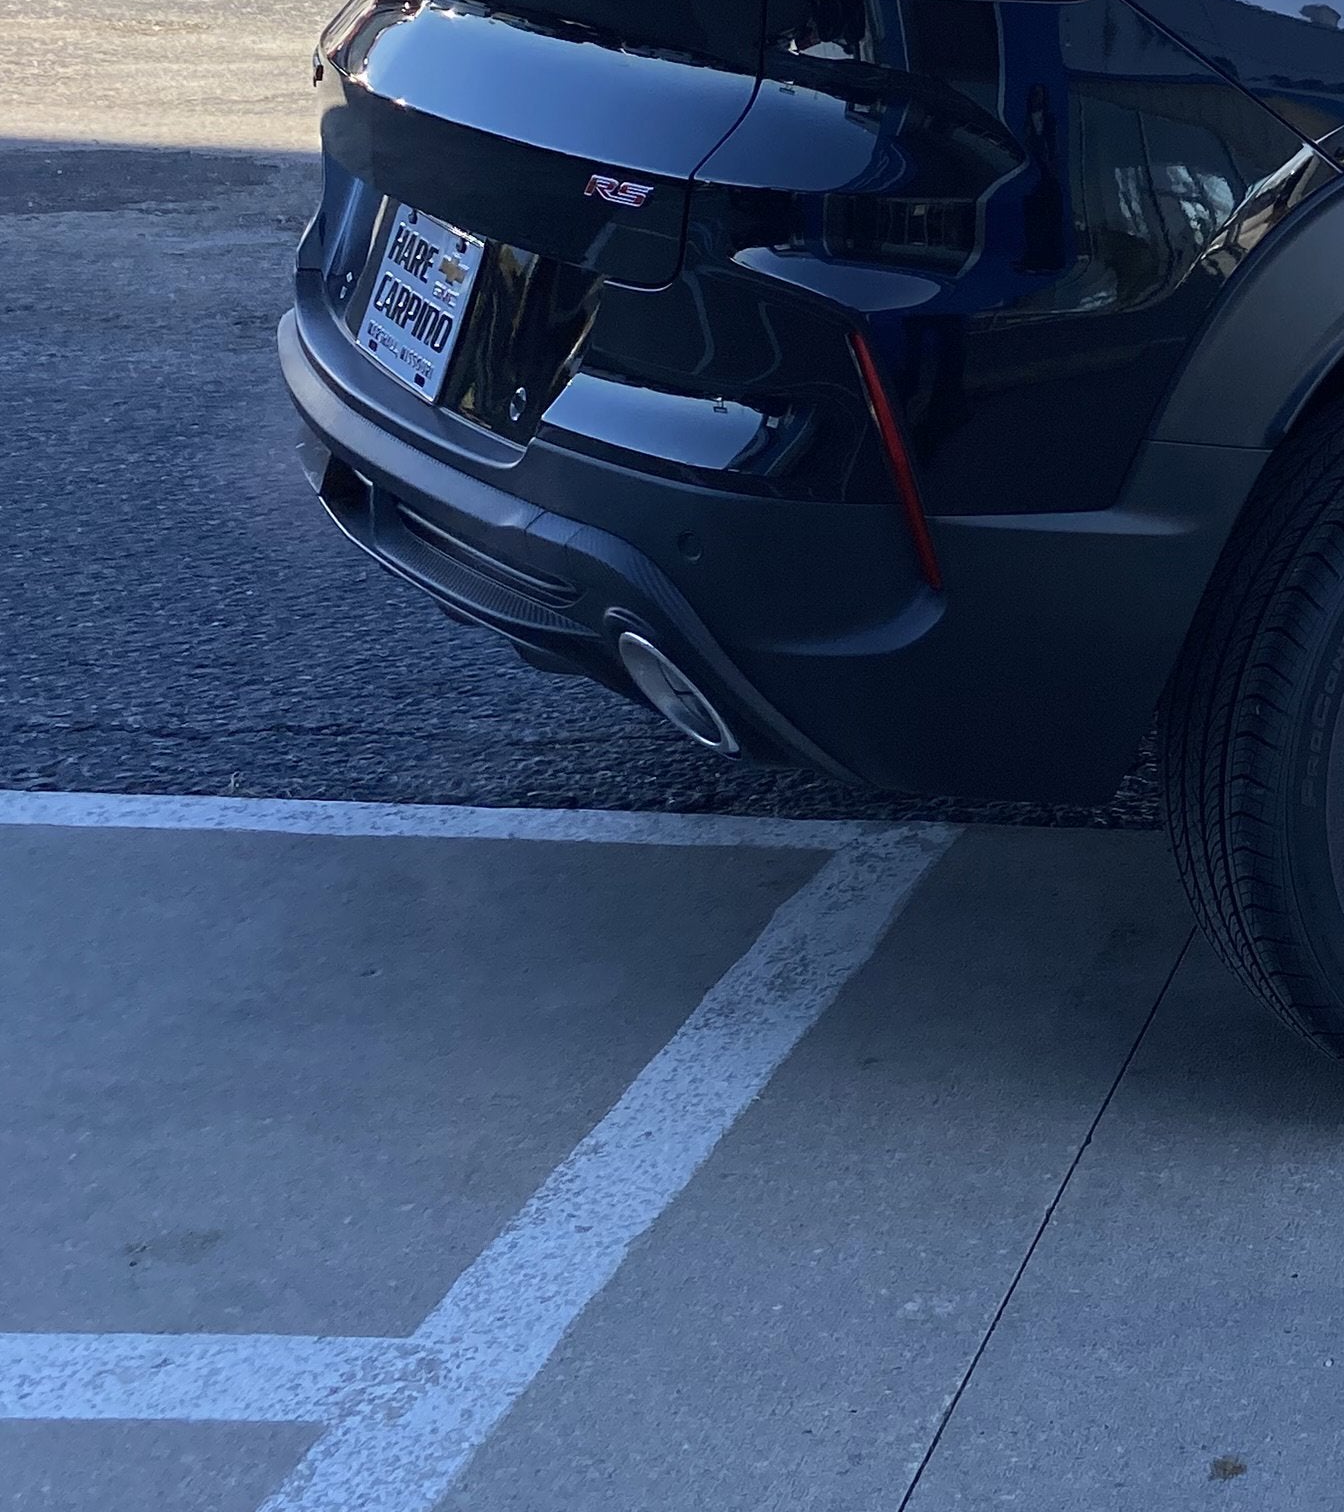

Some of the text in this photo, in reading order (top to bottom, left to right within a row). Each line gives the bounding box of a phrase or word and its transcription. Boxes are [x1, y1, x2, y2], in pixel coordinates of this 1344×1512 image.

[583, 174, 654, 207] RS
[387, 221, 440, 284] HARE
[373, 271, 454, 354] CARPINO
